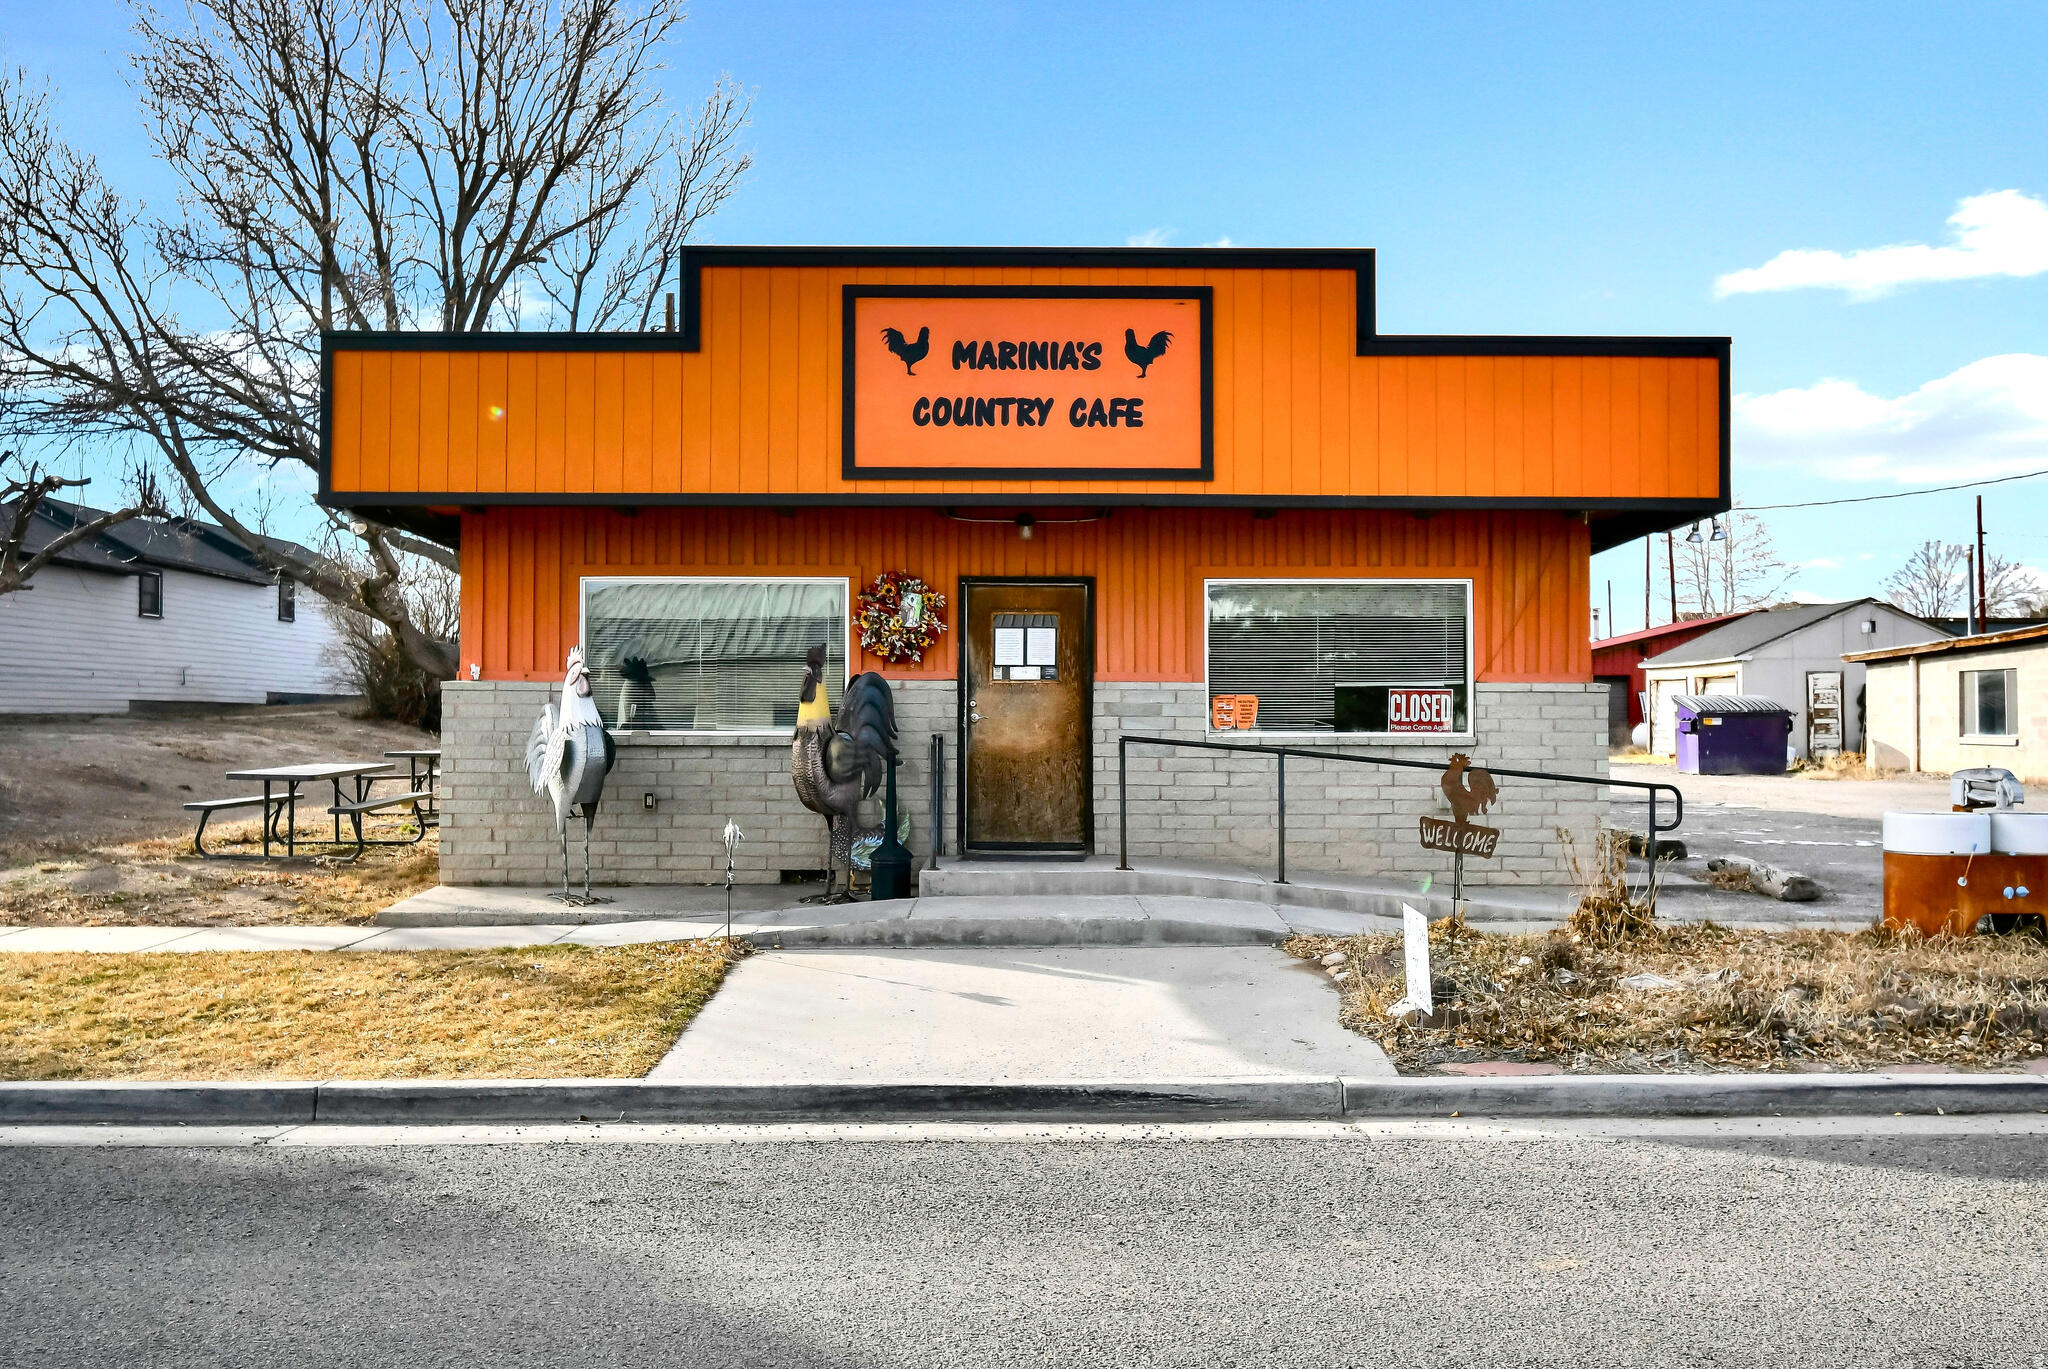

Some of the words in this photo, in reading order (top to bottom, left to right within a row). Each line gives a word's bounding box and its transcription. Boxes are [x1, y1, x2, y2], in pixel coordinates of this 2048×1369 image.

[952, 340, 1102, 370] MARINIA'S
[912, 396, 1054, 427] COUNTRY
[1069, 397, 1144, 428] CAFE
[1390, 694, 1451, 722] CLOSED
[1422, 823, 1495, 853] WELCOME
